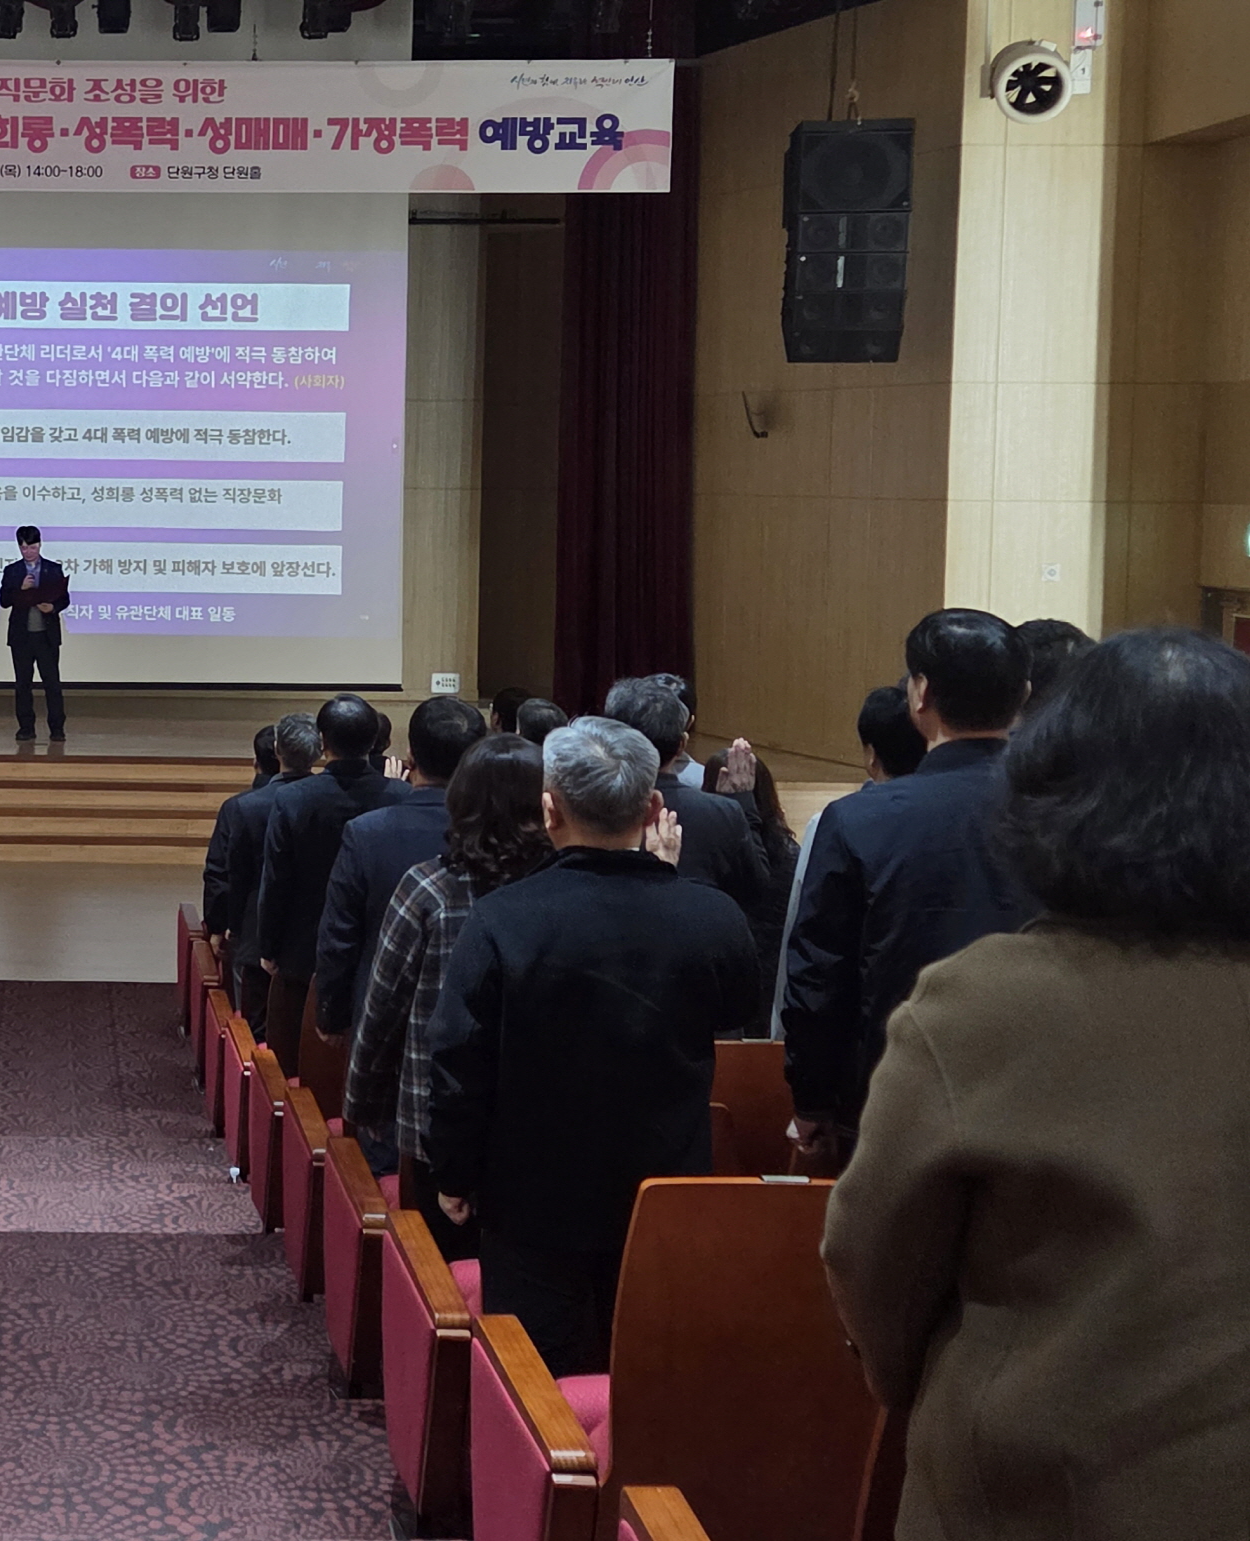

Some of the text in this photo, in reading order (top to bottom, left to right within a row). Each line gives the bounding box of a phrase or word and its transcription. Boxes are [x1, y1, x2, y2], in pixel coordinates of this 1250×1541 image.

[83, 77, 164, 104] 조성을
[172, 78, 227, 103] 위한
[478, 114, 624, 153] 예방교육
[26, 165, 102, 177] 14:00-18:00
[134, 166, 157, 178] 장소
[167, 165, 261, 179] 단원구청 단원홀
[58, 291, 118, 321] 실천
[128, 292, 188, 321] 결의
[198, 292, 258, 322] 선언
[40, 344, 102, 361] 리더로서
[143, 345, 174, 362] 폭력
[235, 346, 266, 363] 적극
[270, 346, 336, 363] 동참하여
[8, 369, 40, 386] 것을
[46, 369, 126, 386] 다짐하면서
[132, 370, 180, 387] 다음과
[184, 370, 215, 387] 같이
[220, 371, 288, 388] 서약한다.
[294, 374, 344, 388] (사회자)
[48, 426, 78, 442] 갖고
[81, 426, 108, 443] 4대
[111, 427, 140, 443] 폭력
[145, 427, 189, 443] 예방에
[193, 428, 224, 444] 적극
[226, 428, 291, 445] 동참한다.
[22, 485, 86, 503] 이수하고,
[90, 486, 135, 502] 성희롱
[139, 487, 183, 502] 성폭력
[188, 487, 218, 503] 없는
[222, 488, 282, 503] 직장문화
[82, 558, 112, 574] 가해
[117, 558, 147, 574] 방지
[152, 559, 166, 575] 및
[171, 559, 217, 575] 피해자
[220, 560, 266, 576] 보호에
[270, 560, 336, 577] 앞장선다.
[98, 604, 111, 619] 및
[115, 605, 171, 620] 유관단체
[175, 606, 203, 620] 대표
[207, 606, 236, 621] 일동
